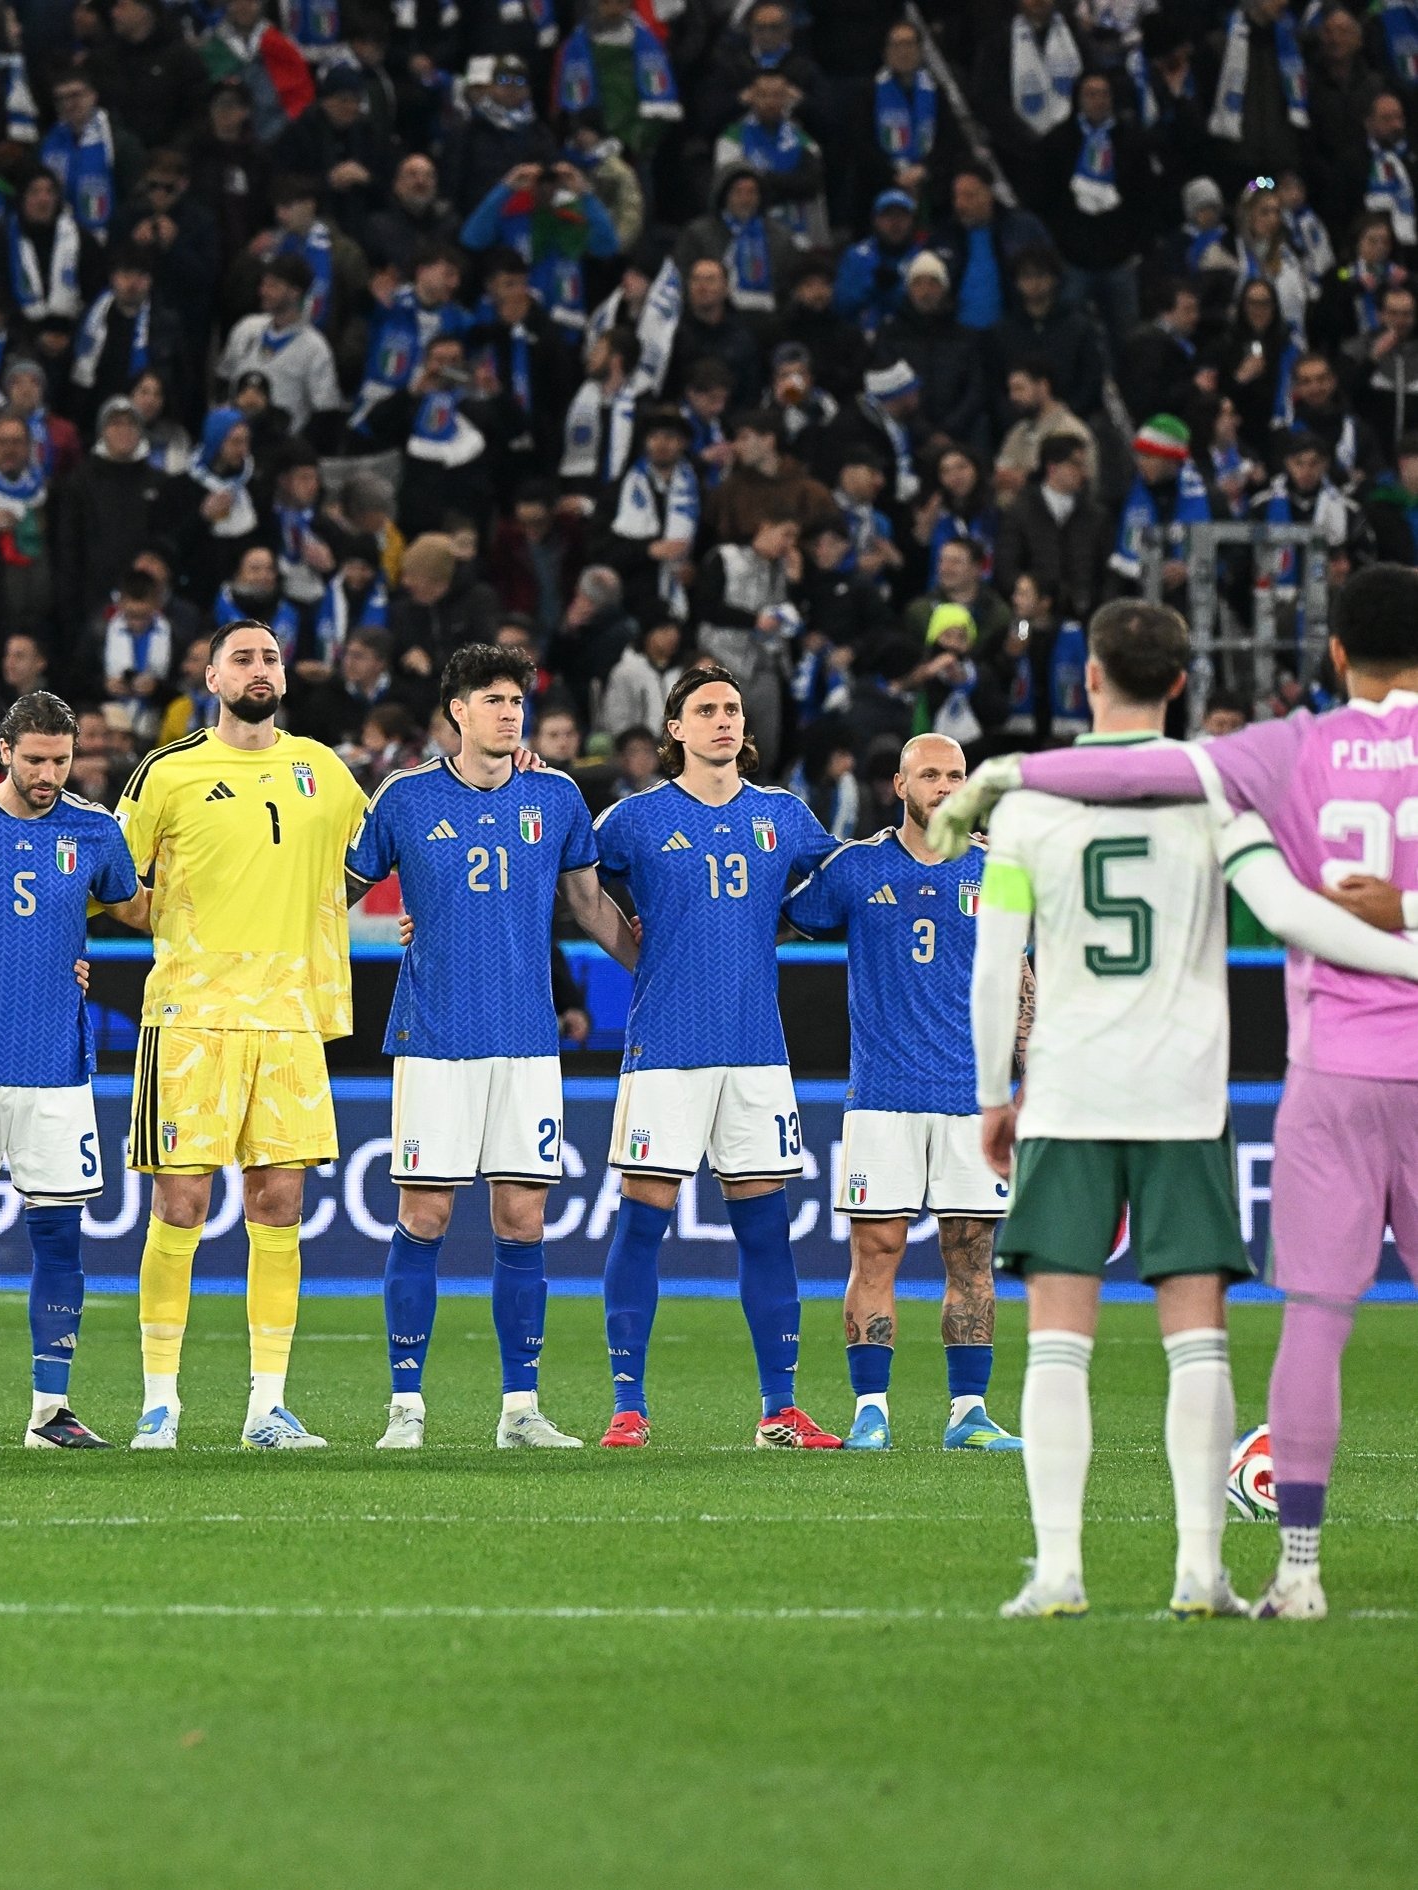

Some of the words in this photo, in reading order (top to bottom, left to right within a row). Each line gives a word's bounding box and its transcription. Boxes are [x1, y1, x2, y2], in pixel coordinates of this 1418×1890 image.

[265, 801, 281, 845] 1
[467, 846, 509, 892] 21
[705, 853, 749, 899] 13
[13, 871, 37, 917] 5
[1083, 836, 1153, 977] 5
[912, 918, 936, 964] 3
[80, 1132, 97, 1178] 5
[774, 1111, 801, 1158] 13
[391, 1332, 426, 1345] ITALIA
